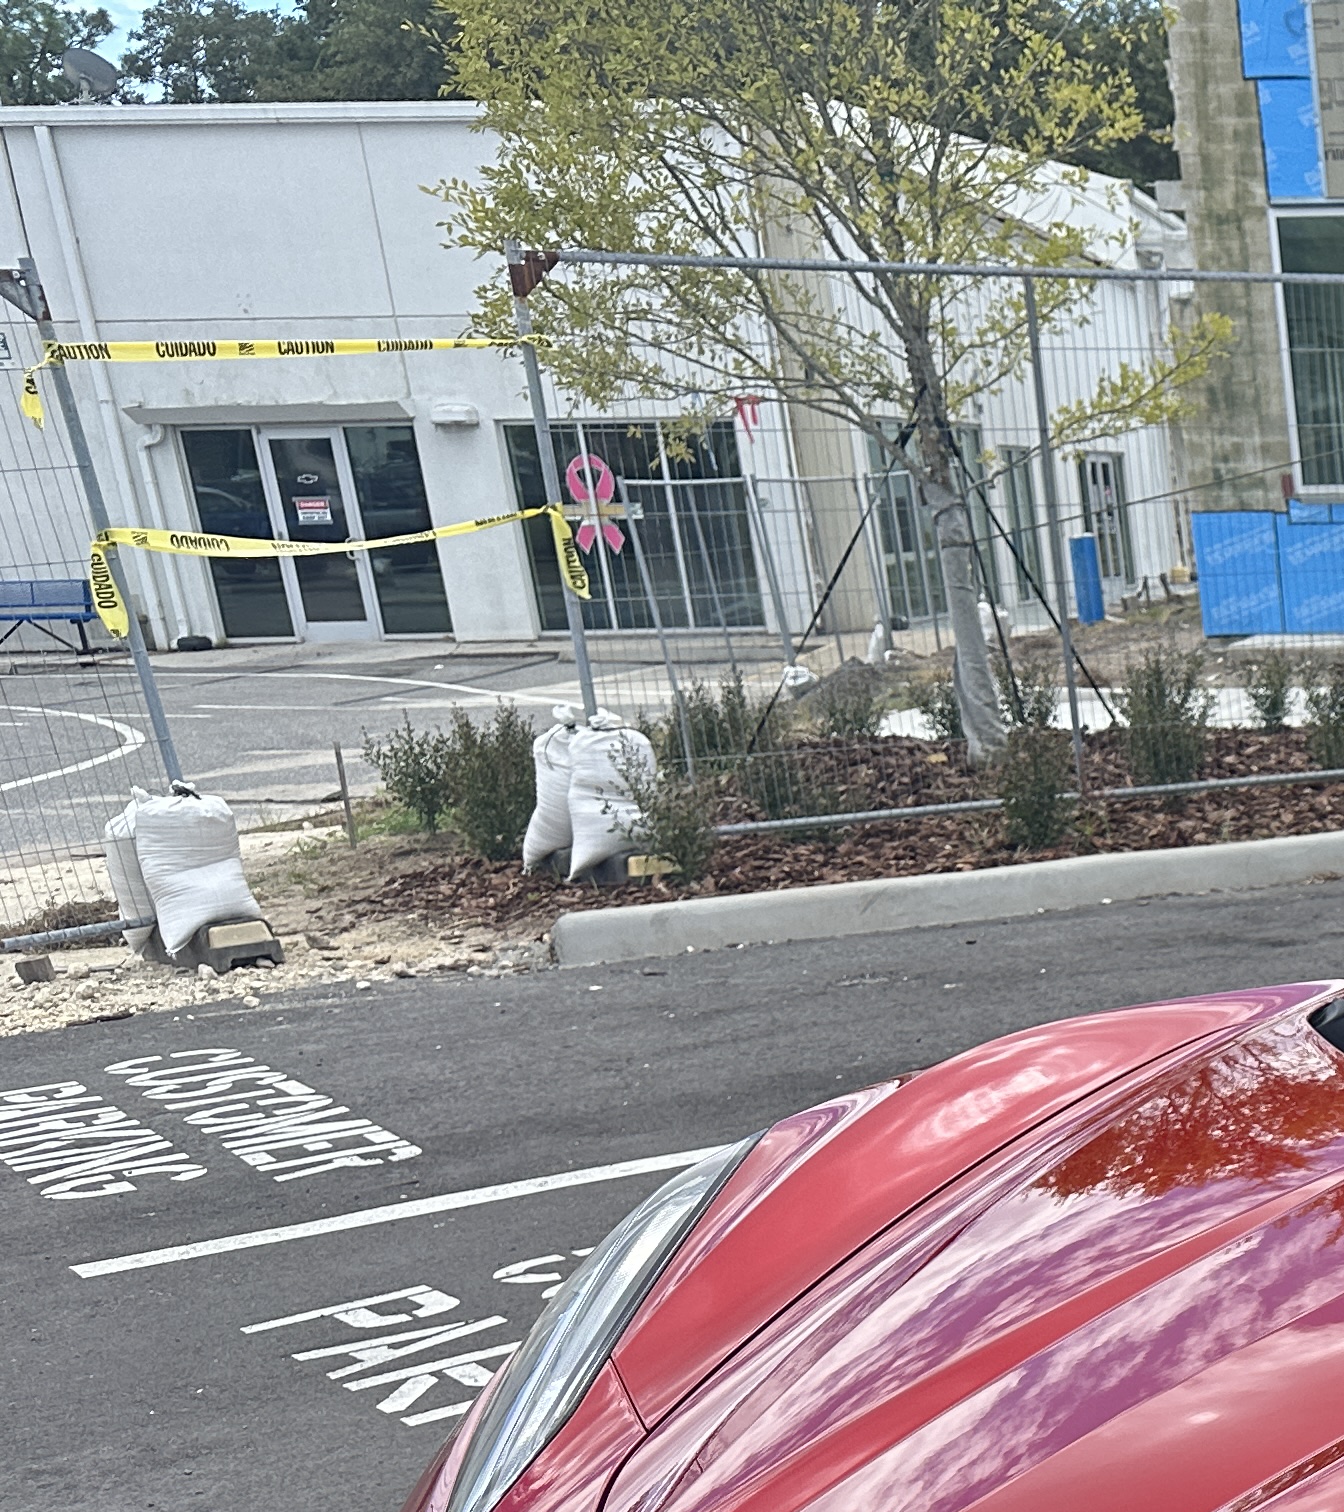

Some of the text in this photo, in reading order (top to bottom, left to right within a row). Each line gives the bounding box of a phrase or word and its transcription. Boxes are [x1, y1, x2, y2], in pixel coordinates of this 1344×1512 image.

[156, 341, 217, 357] CUIDADO
[277, 340, 335, 355] CAUTION
[91, 553, 118, 609] CUIDADO
[104, 1048, 423, 1182] CUSTOMER
[239, 1284, 524, 1427] PAR
